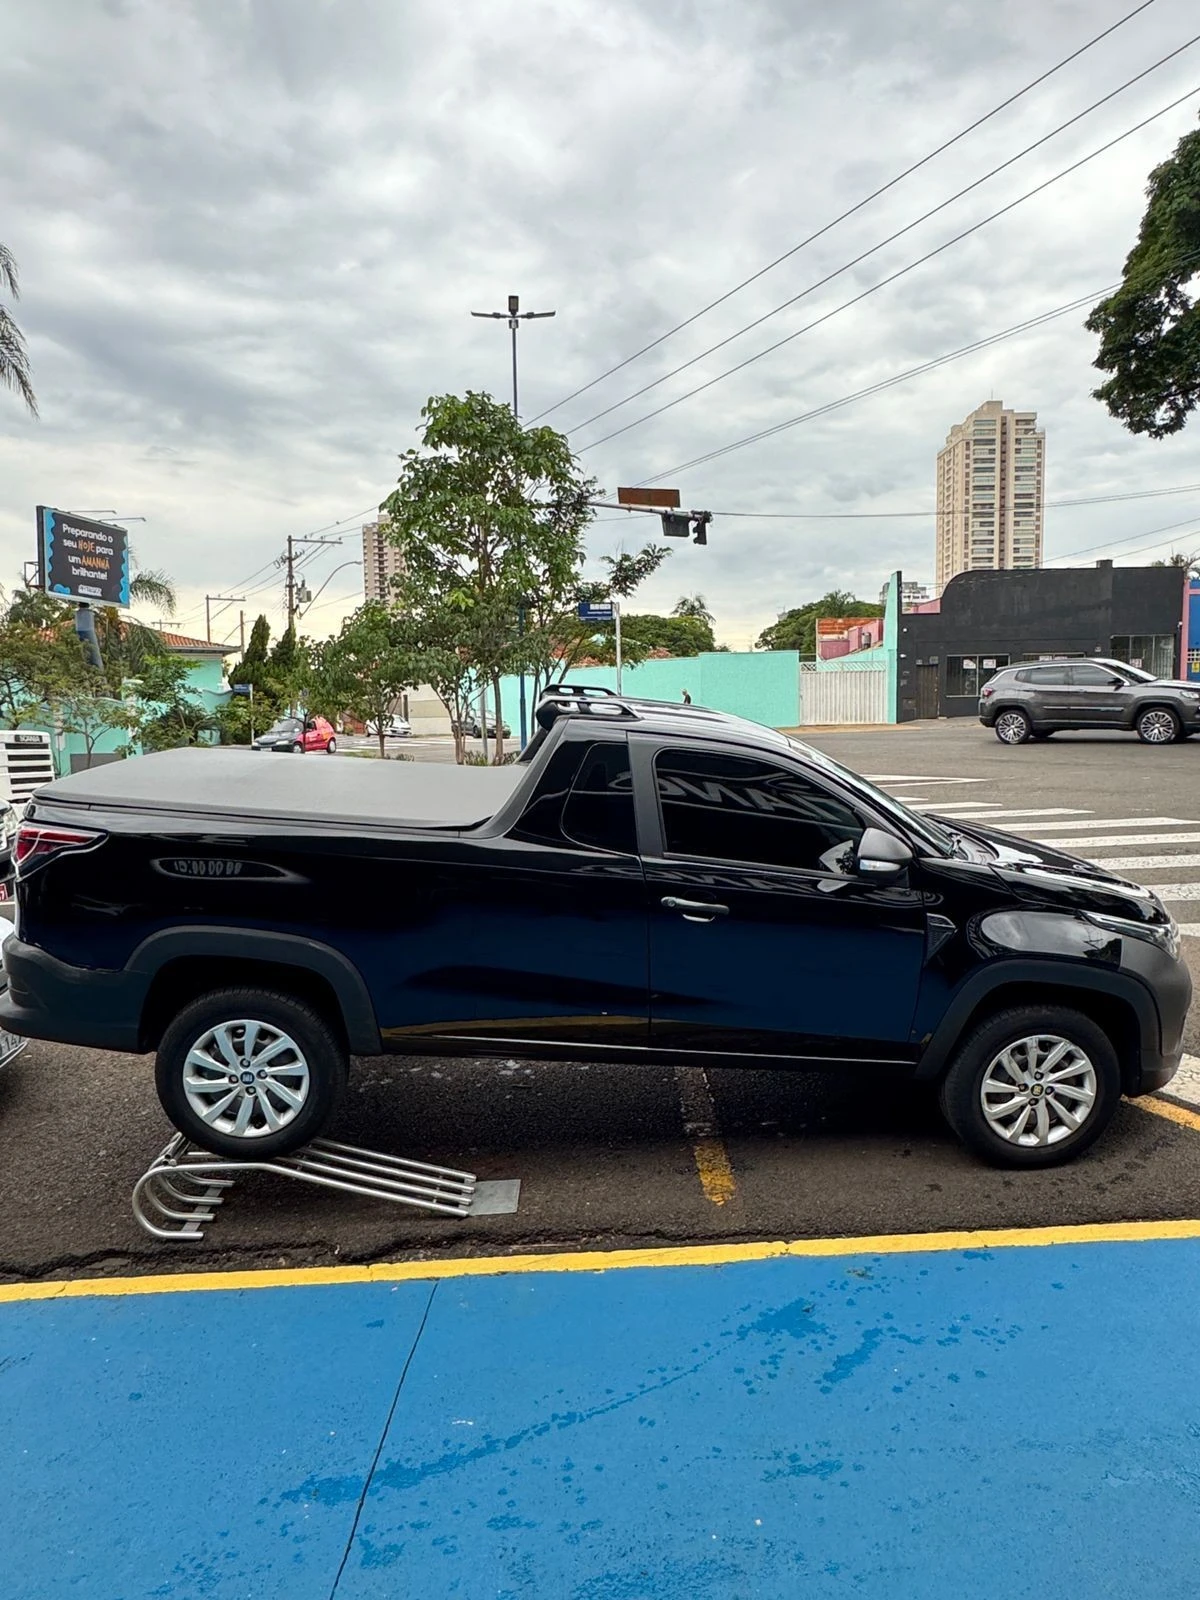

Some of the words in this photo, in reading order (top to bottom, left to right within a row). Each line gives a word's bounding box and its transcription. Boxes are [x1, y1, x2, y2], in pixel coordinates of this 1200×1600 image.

[62, 524, 107, 542] Preparando
[63, 539, 77, 548] seu
[78, 540, 95, 552] HOJE
[96, 546, 113, 556] para
[68, 555, 81, 564] um
[81, 556, 110, 569] AMANHÃ
[71, 567, 108, 580] brilhante!
